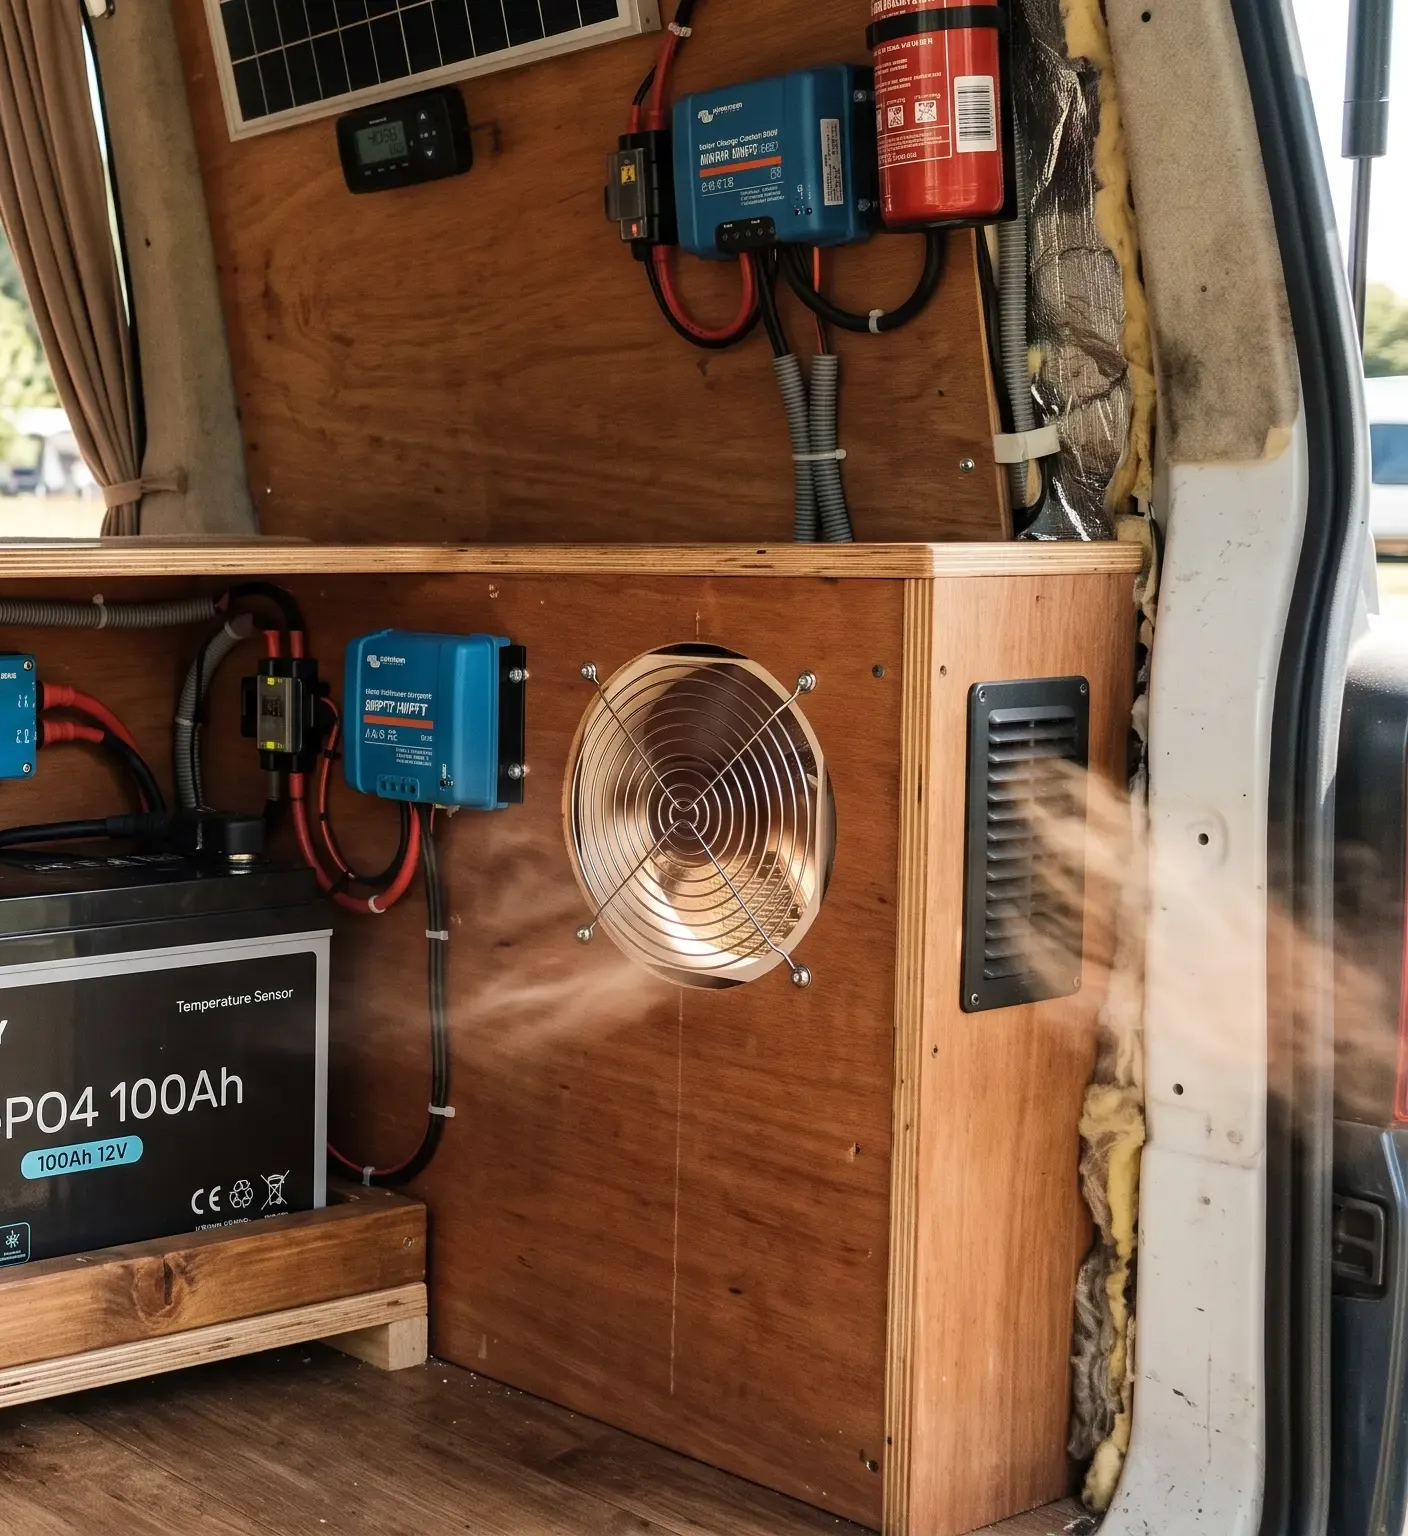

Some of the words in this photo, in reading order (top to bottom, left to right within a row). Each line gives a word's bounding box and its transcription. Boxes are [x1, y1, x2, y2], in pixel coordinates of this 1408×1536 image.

[176, 994, 252, 1013] Temperature
[254, 988, 294, 1003] Sensor
[110, 1066, 243, 1122] 100Ah
[37, 1149, 92, 1172] 100Ah
[97, 1142, 128, 1162] 12V
